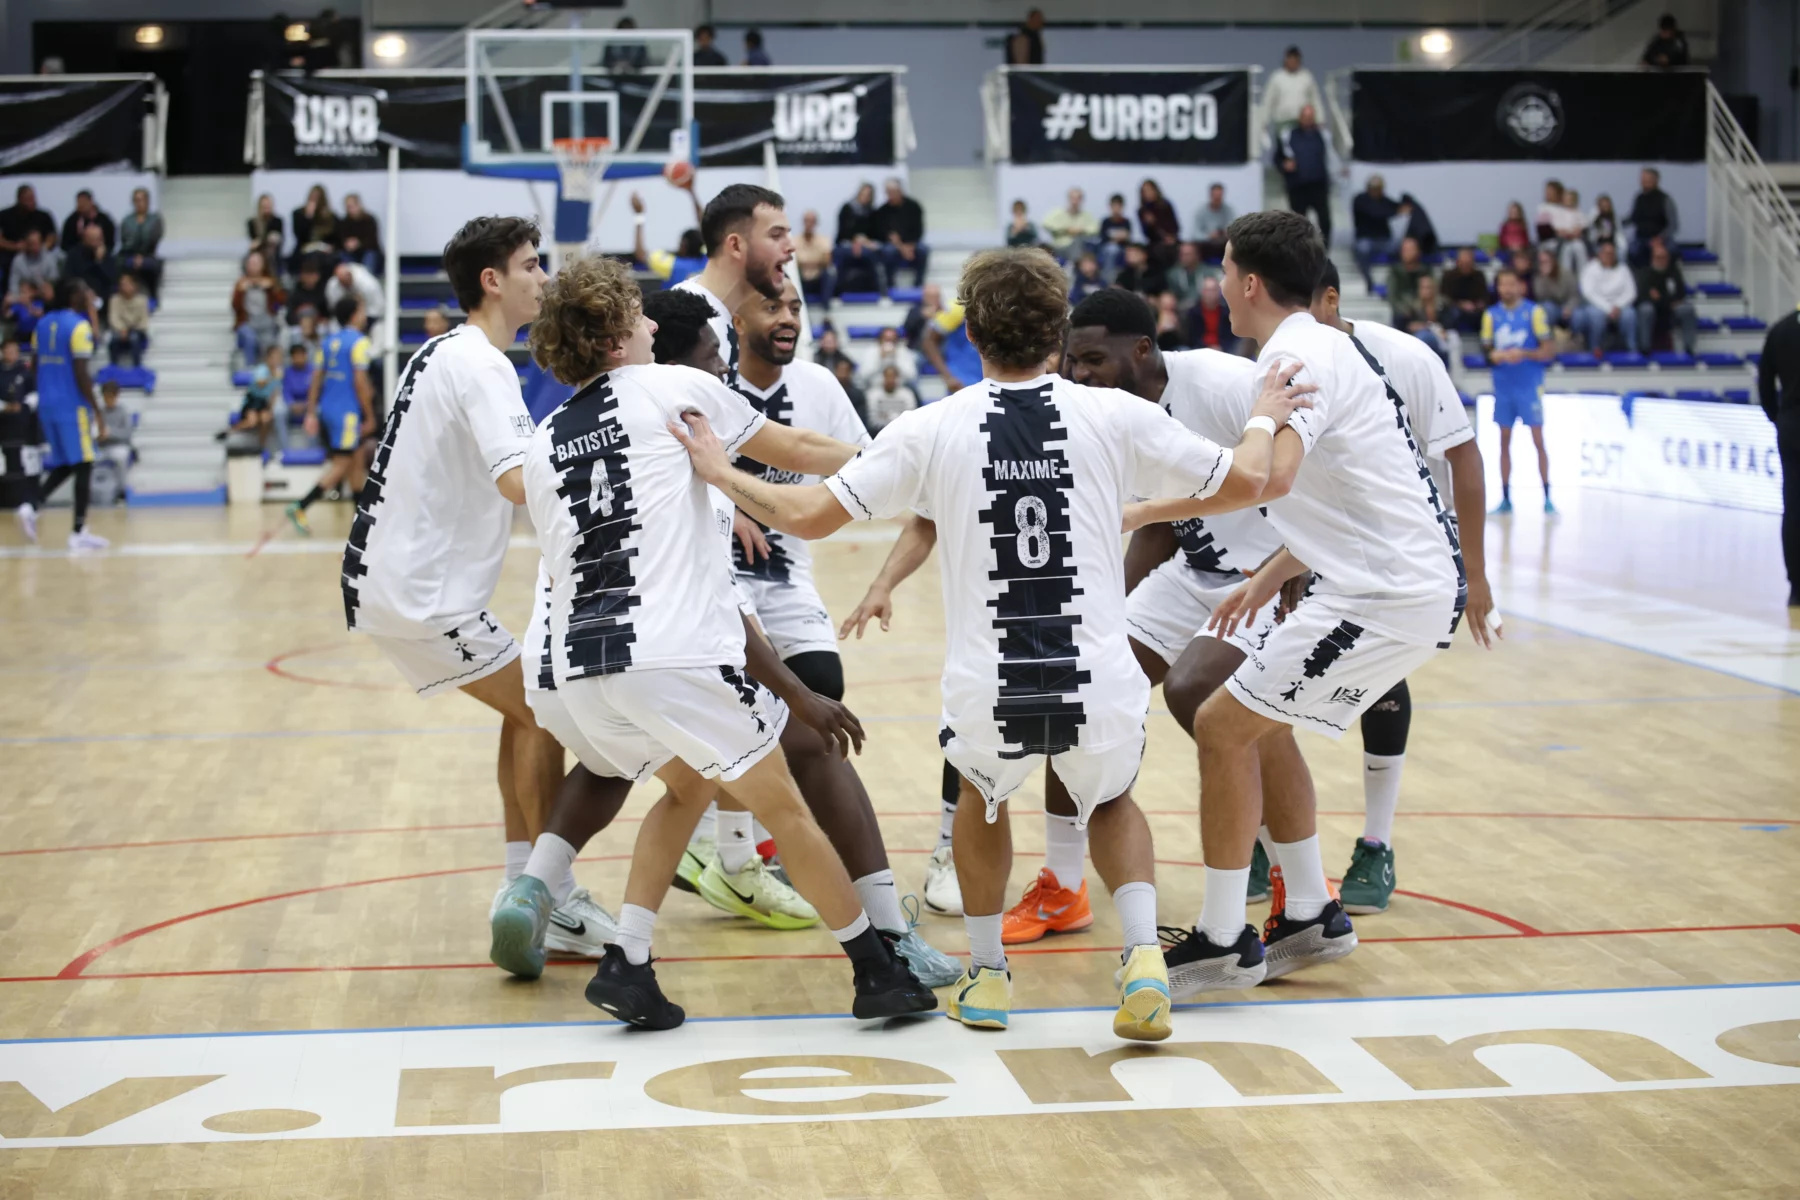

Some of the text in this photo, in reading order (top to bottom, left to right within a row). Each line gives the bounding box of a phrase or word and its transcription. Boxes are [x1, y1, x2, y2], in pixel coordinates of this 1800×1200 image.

[1041, 93, 1218, 141] #URBGO
[556, 424, 620, 463] BATISTE
[589, 458, 615, 517] 4
[994, 459, 1060, 480] MAXIME
[1015, 495, 1050, 569] 8
